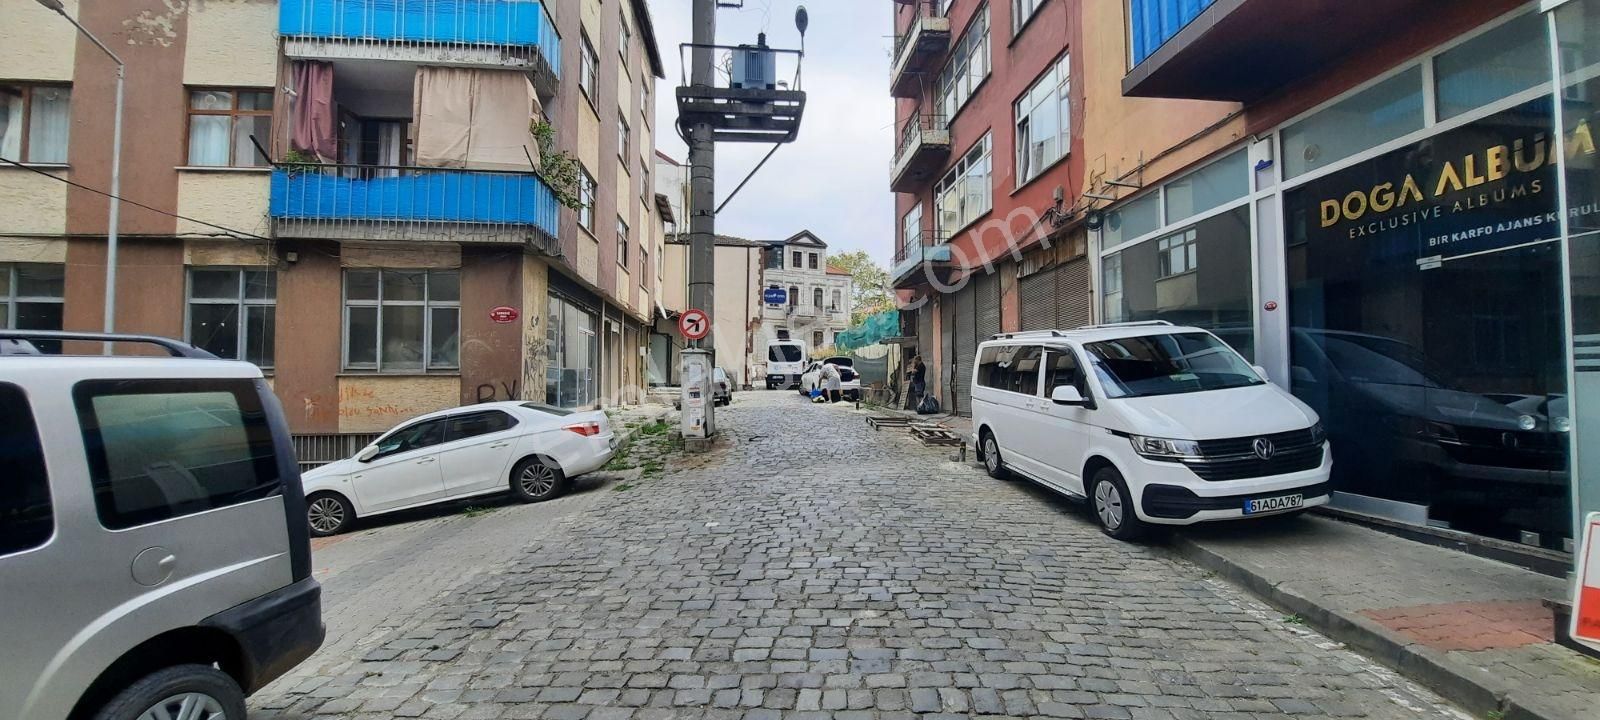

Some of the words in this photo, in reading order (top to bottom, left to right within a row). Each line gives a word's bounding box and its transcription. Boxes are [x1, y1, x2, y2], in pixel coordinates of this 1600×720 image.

[1452, 179, 1542, 213] ALBUMS
[1451, 226, 1493, 242] KARFO
[1496, 215, 1543, 233] AJANS
[1546, 203, 1600, 222] KRUL
[1250, 494, 1302, 512] 61ADA787
